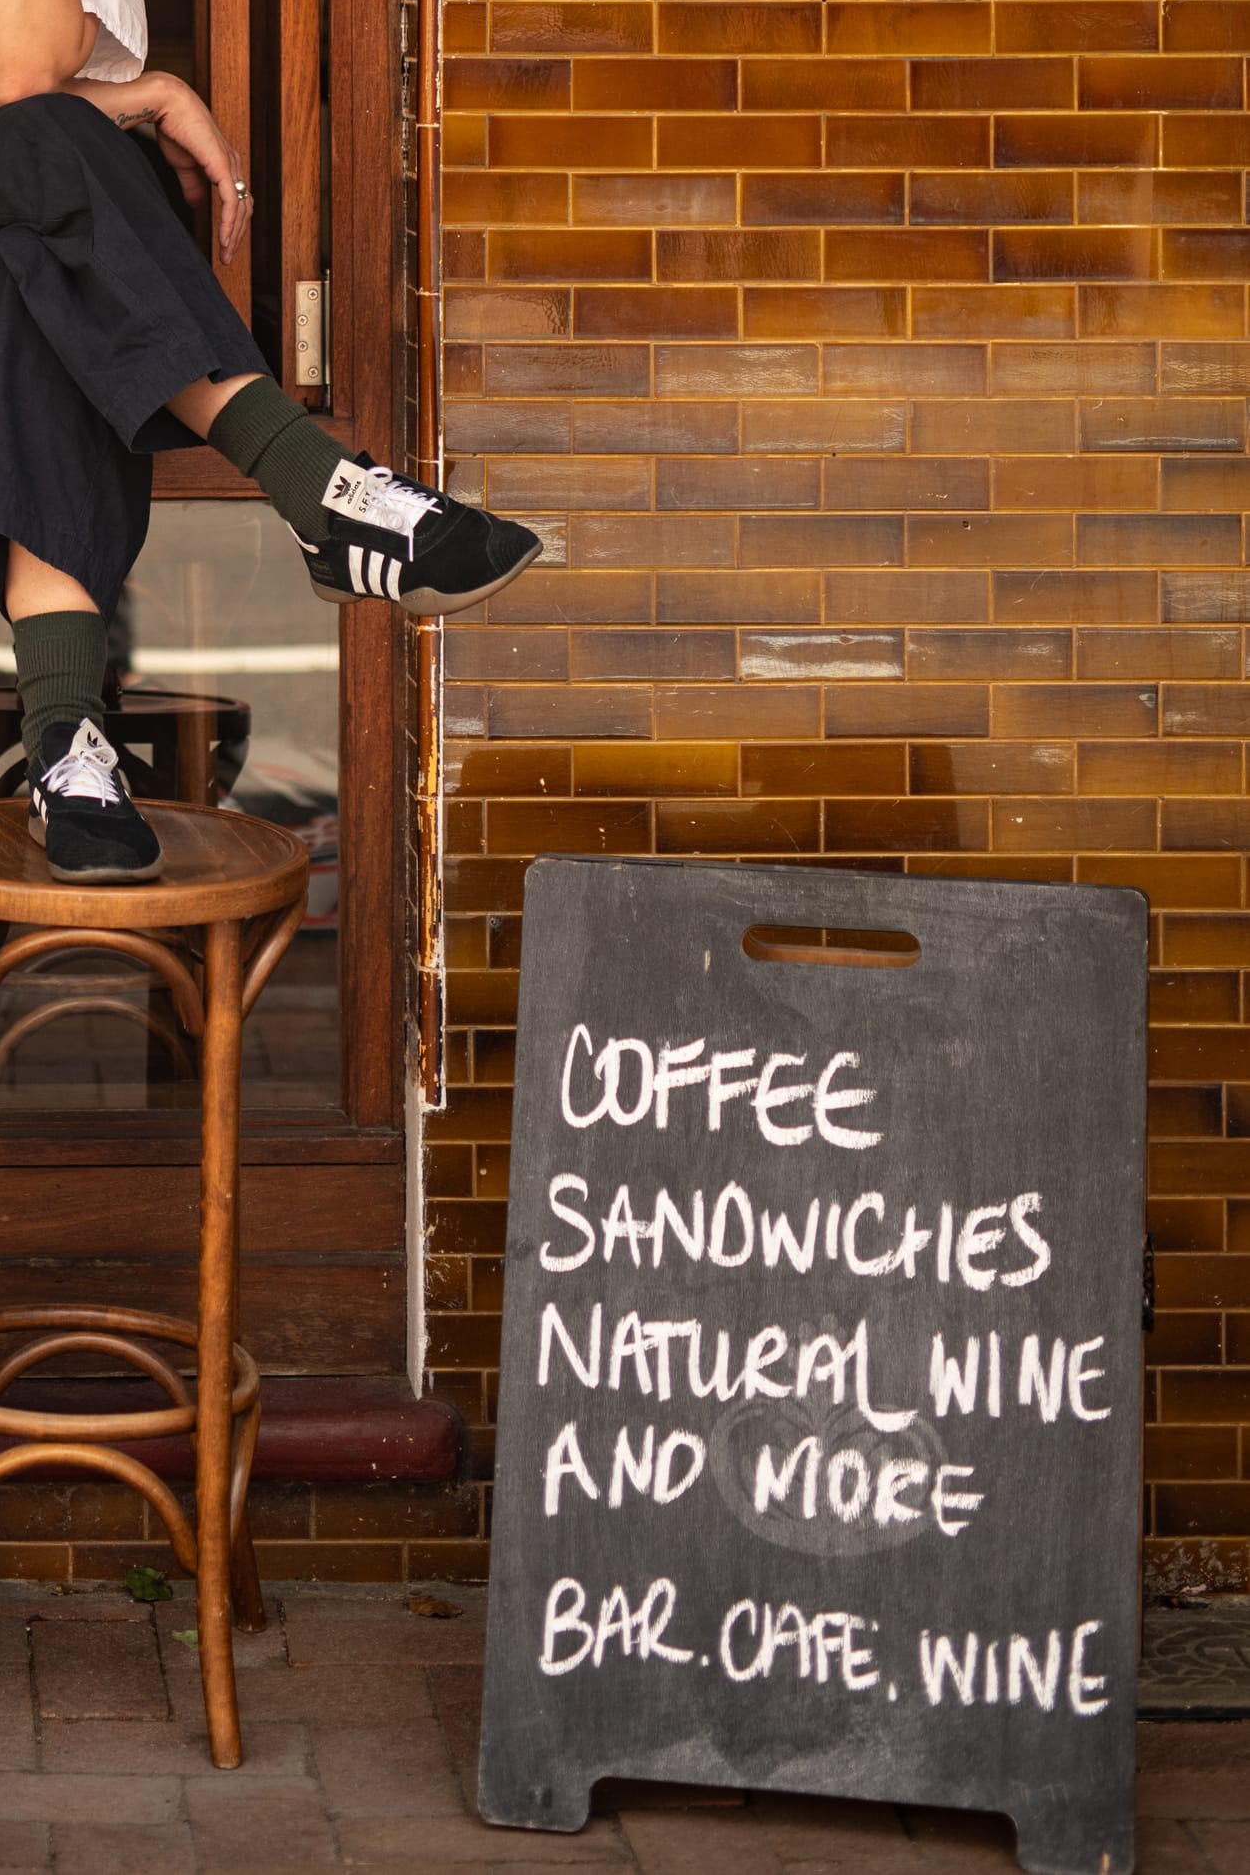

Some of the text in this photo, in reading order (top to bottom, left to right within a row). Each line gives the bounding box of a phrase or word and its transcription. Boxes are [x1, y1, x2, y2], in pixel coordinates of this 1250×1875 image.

[347, 480, 362, 505] adidas
[560, 1023, 884, 1150] COFFEE
[538, 1172, 1052, 1292] SANDWICHES
[538, 1302, 1112, 1433] NATURAL WINE
[545, 1421, 985, 1536] AND MORE
[920, 1620, 1111, 1715] WINE
